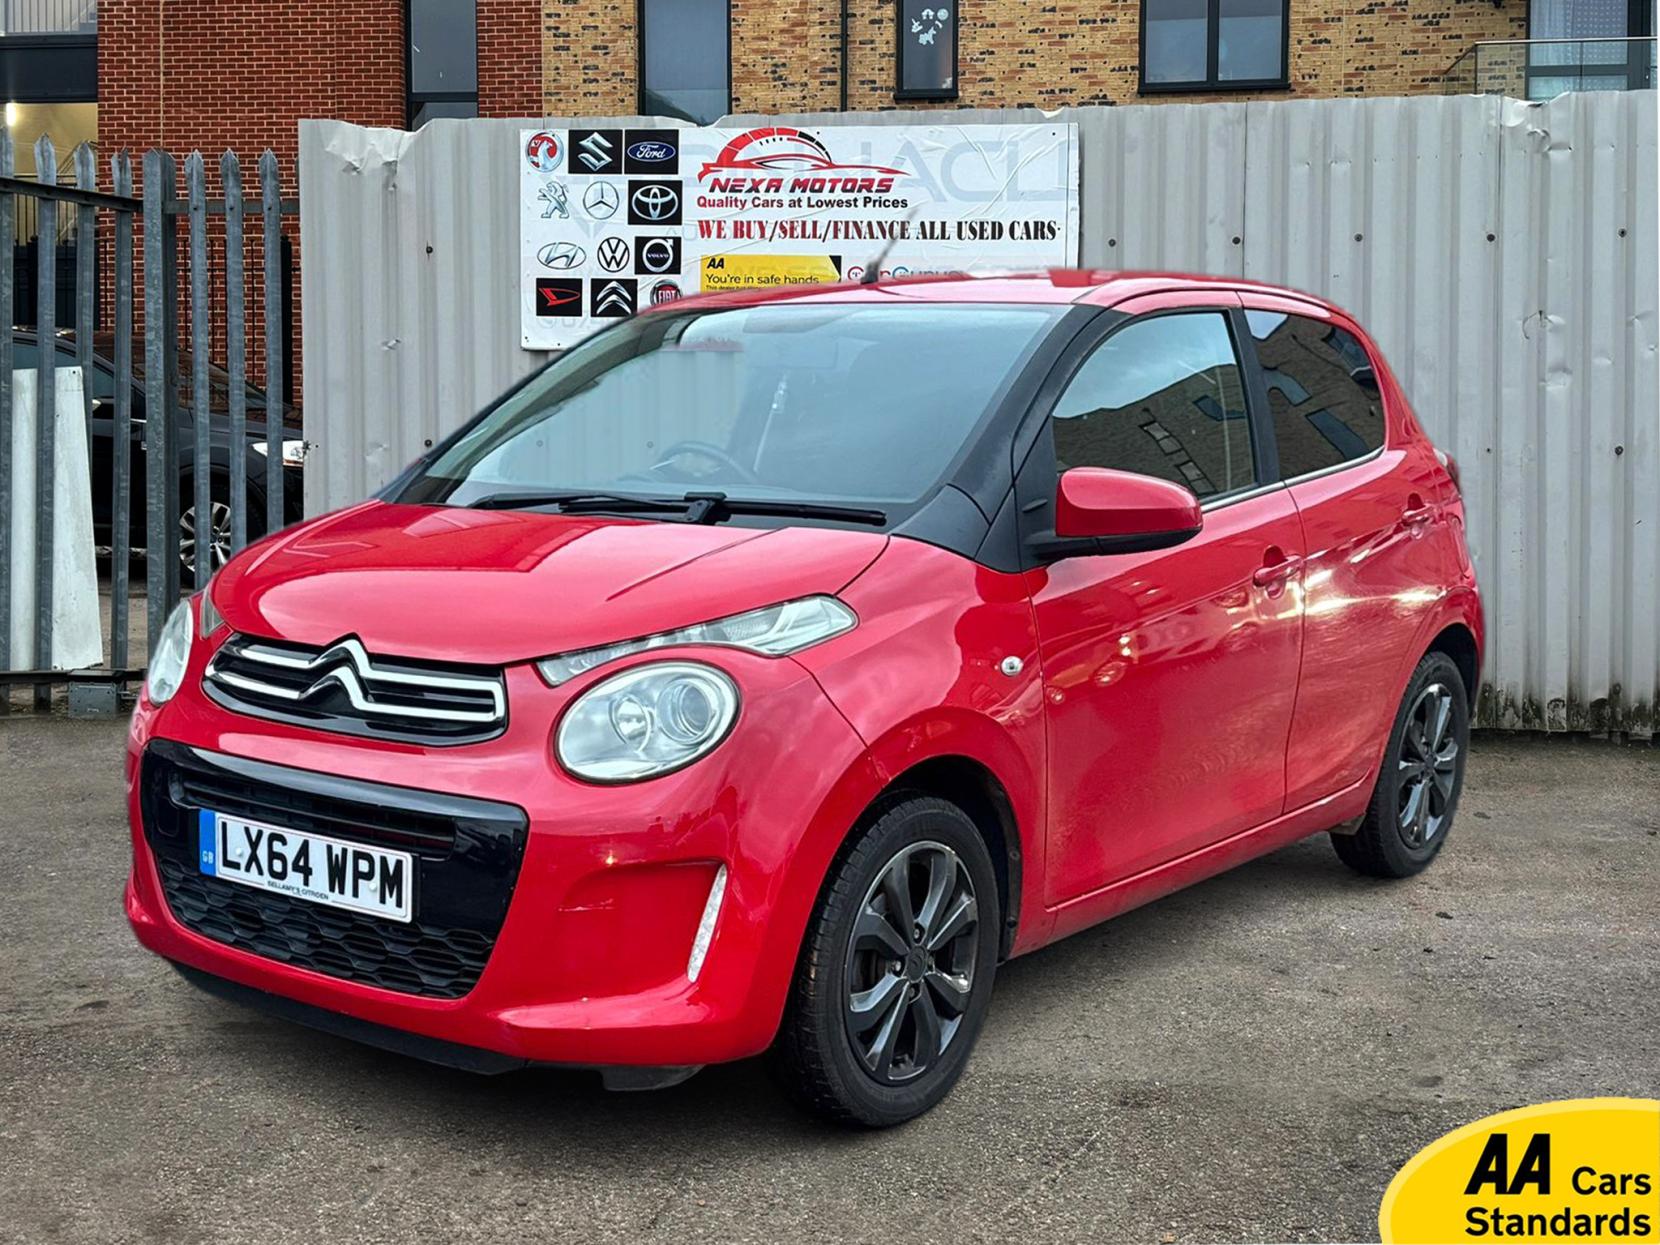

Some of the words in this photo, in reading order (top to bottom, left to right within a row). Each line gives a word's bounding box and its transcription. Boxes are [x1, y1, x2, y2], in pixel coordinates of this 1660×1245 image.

[636, 144, 666, 158] Ford
[709, 178, 783, 193] NEXA
[789, 178, 894, 193] MOTORS
[697, 196, 747, 210] Quality
[752, 196, 784, 208] Cars
[788, 197, 802, 208] at
[807, 196, 858, 208] Lowest
[867, 197, 908, 208] Prices
[698, 220, 726, 239] WE
[916, 221, 950, 240] ALL
[956, 221, 1003, 240] USED
[706, 258, 725, 269] AA
[706, 273, 740, 284] You're
[744, 274, 754, 283] in
[757, 273, 781, 284] safe
[784, 274, 819, 285] hands
[202, 850, 214, 865] GB
[221, 821, 312, 887] LX64
[326, 844, 403, 909] WPM
